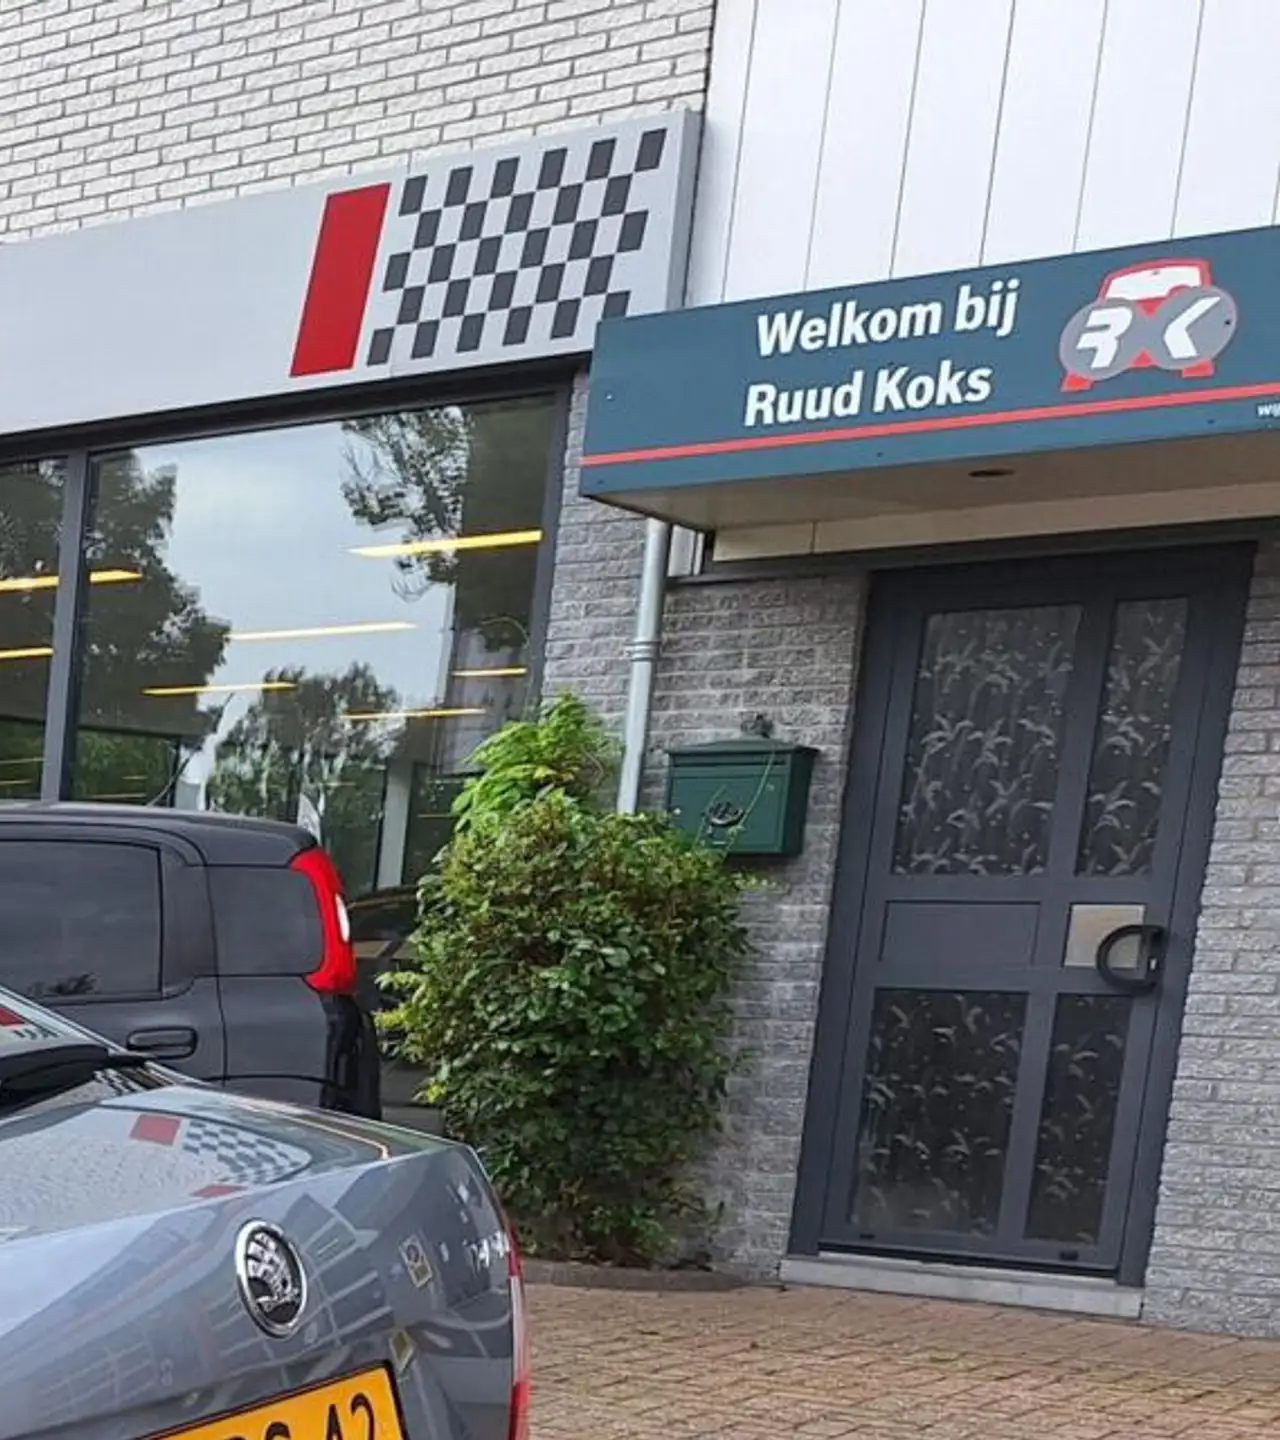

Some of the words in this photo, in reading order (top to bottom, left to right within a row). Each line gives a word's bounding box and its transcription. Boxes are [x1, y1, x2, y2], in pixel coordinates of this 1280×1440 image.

[757, 300, 943, 357] Welkom
[954, 278, 1021, 337] bij
[744, 369, 865, 427] Ruud
[872, 359, 993, 413] Koks
